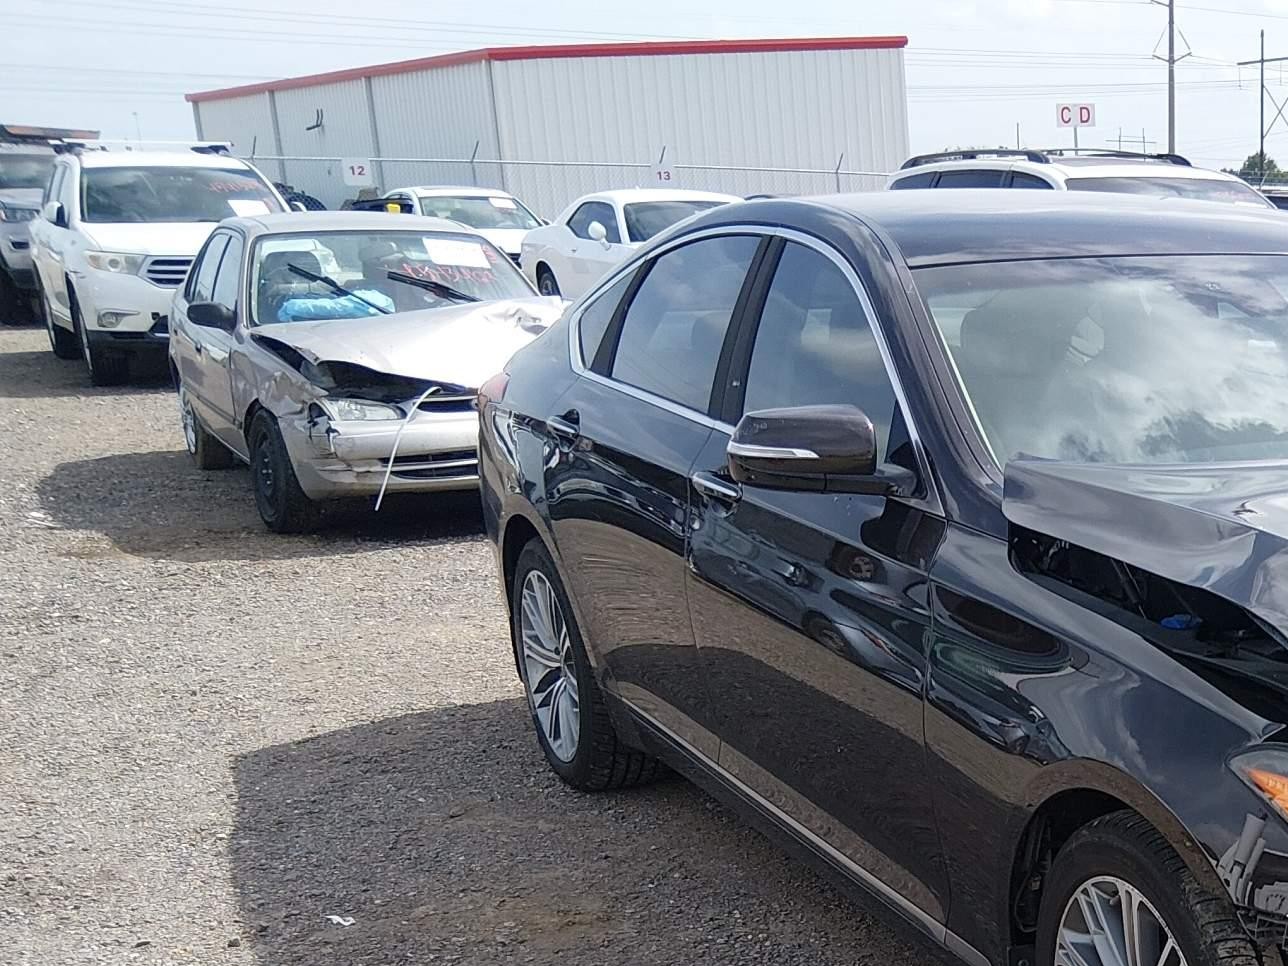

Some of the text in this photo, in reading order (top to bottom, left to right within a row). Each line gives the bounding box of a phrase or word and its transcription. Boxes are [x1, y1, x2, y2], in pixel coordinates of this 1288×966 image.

[1060, 106, 1091, 124] C D
[349, 165, 366, 176] 12
[656, 170, 671, 181] 13
